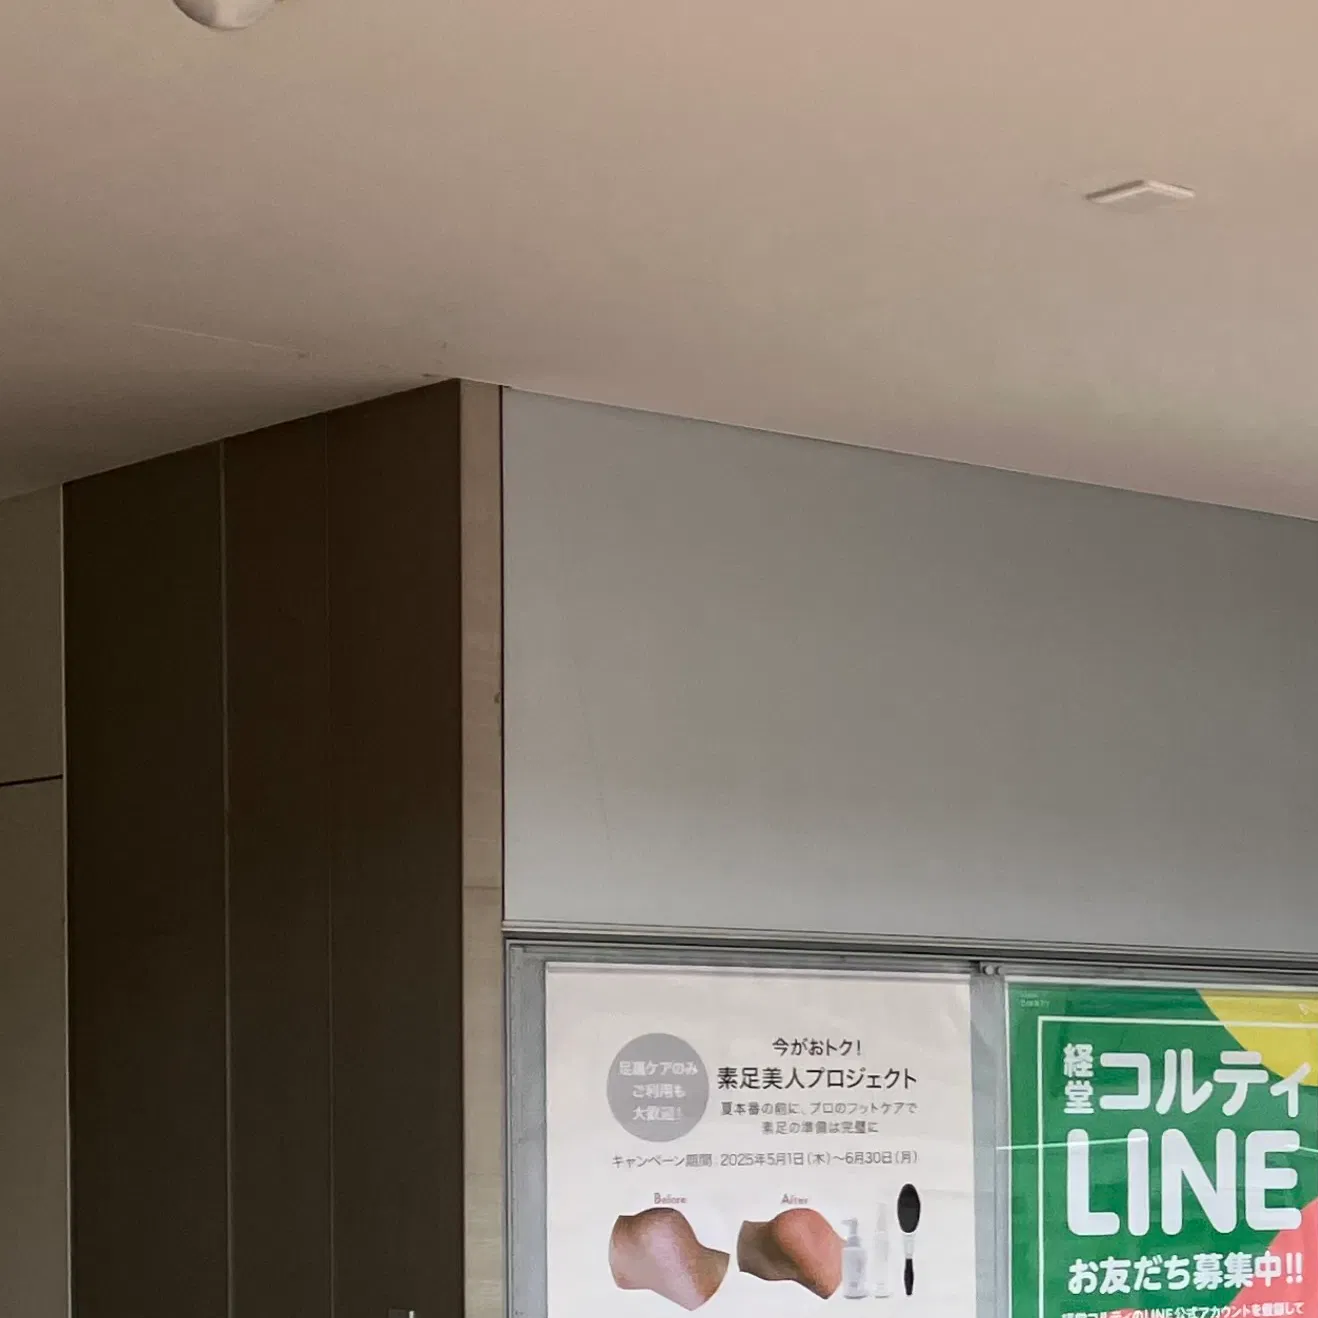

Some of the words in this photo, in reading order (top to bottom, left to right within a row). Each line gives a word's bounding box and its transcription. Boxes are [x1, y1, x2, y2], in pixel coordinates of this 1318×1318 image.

[717, 1067, 918, 1090] 素足美人プロジェクト
[1063, 1043, 1095, 1114] 経堂
[1099, 1048, 1313, 1118] コルティ
[1066, 1128, 1303, 1237] LINE
